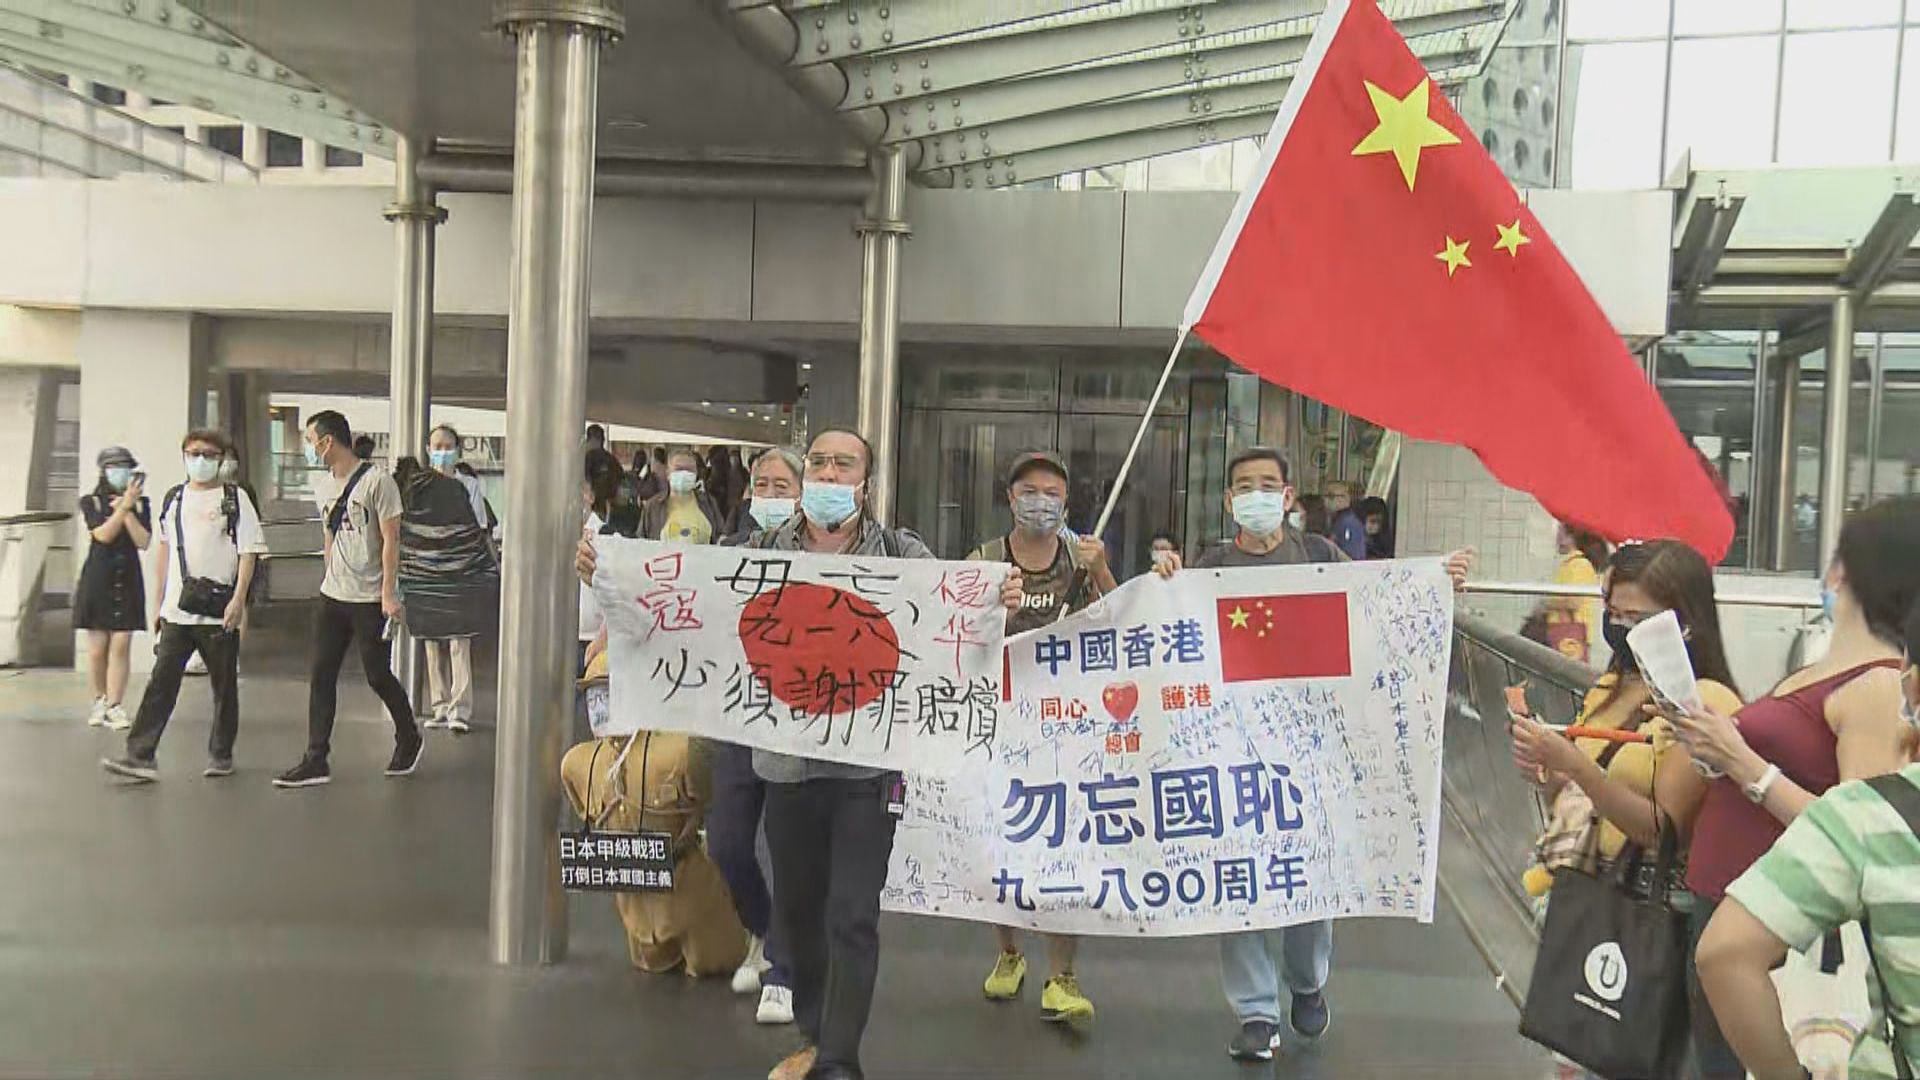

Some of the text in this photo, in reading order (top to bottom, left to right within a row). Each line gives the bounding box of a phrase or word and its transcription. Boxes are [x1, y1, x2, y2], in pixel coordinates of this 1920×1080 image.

[742, 611, 921, 662] 九一八
[1034, 618, 1206, 675] 中國香港
[650, 648, 999, 760] 必須謝罪賠償
[1041, 697, 1087, 720] 同心
[1105, 732, 1142, 755] 總會
[1002, 760, 1305, 849] 勿忘國恥
[561, 837, 666, 861] 日本甲級戰犯
[562, 867, 672, 887] 打倒日本軍國主義
[991, 853, 1308, 912] 九一八90周年
